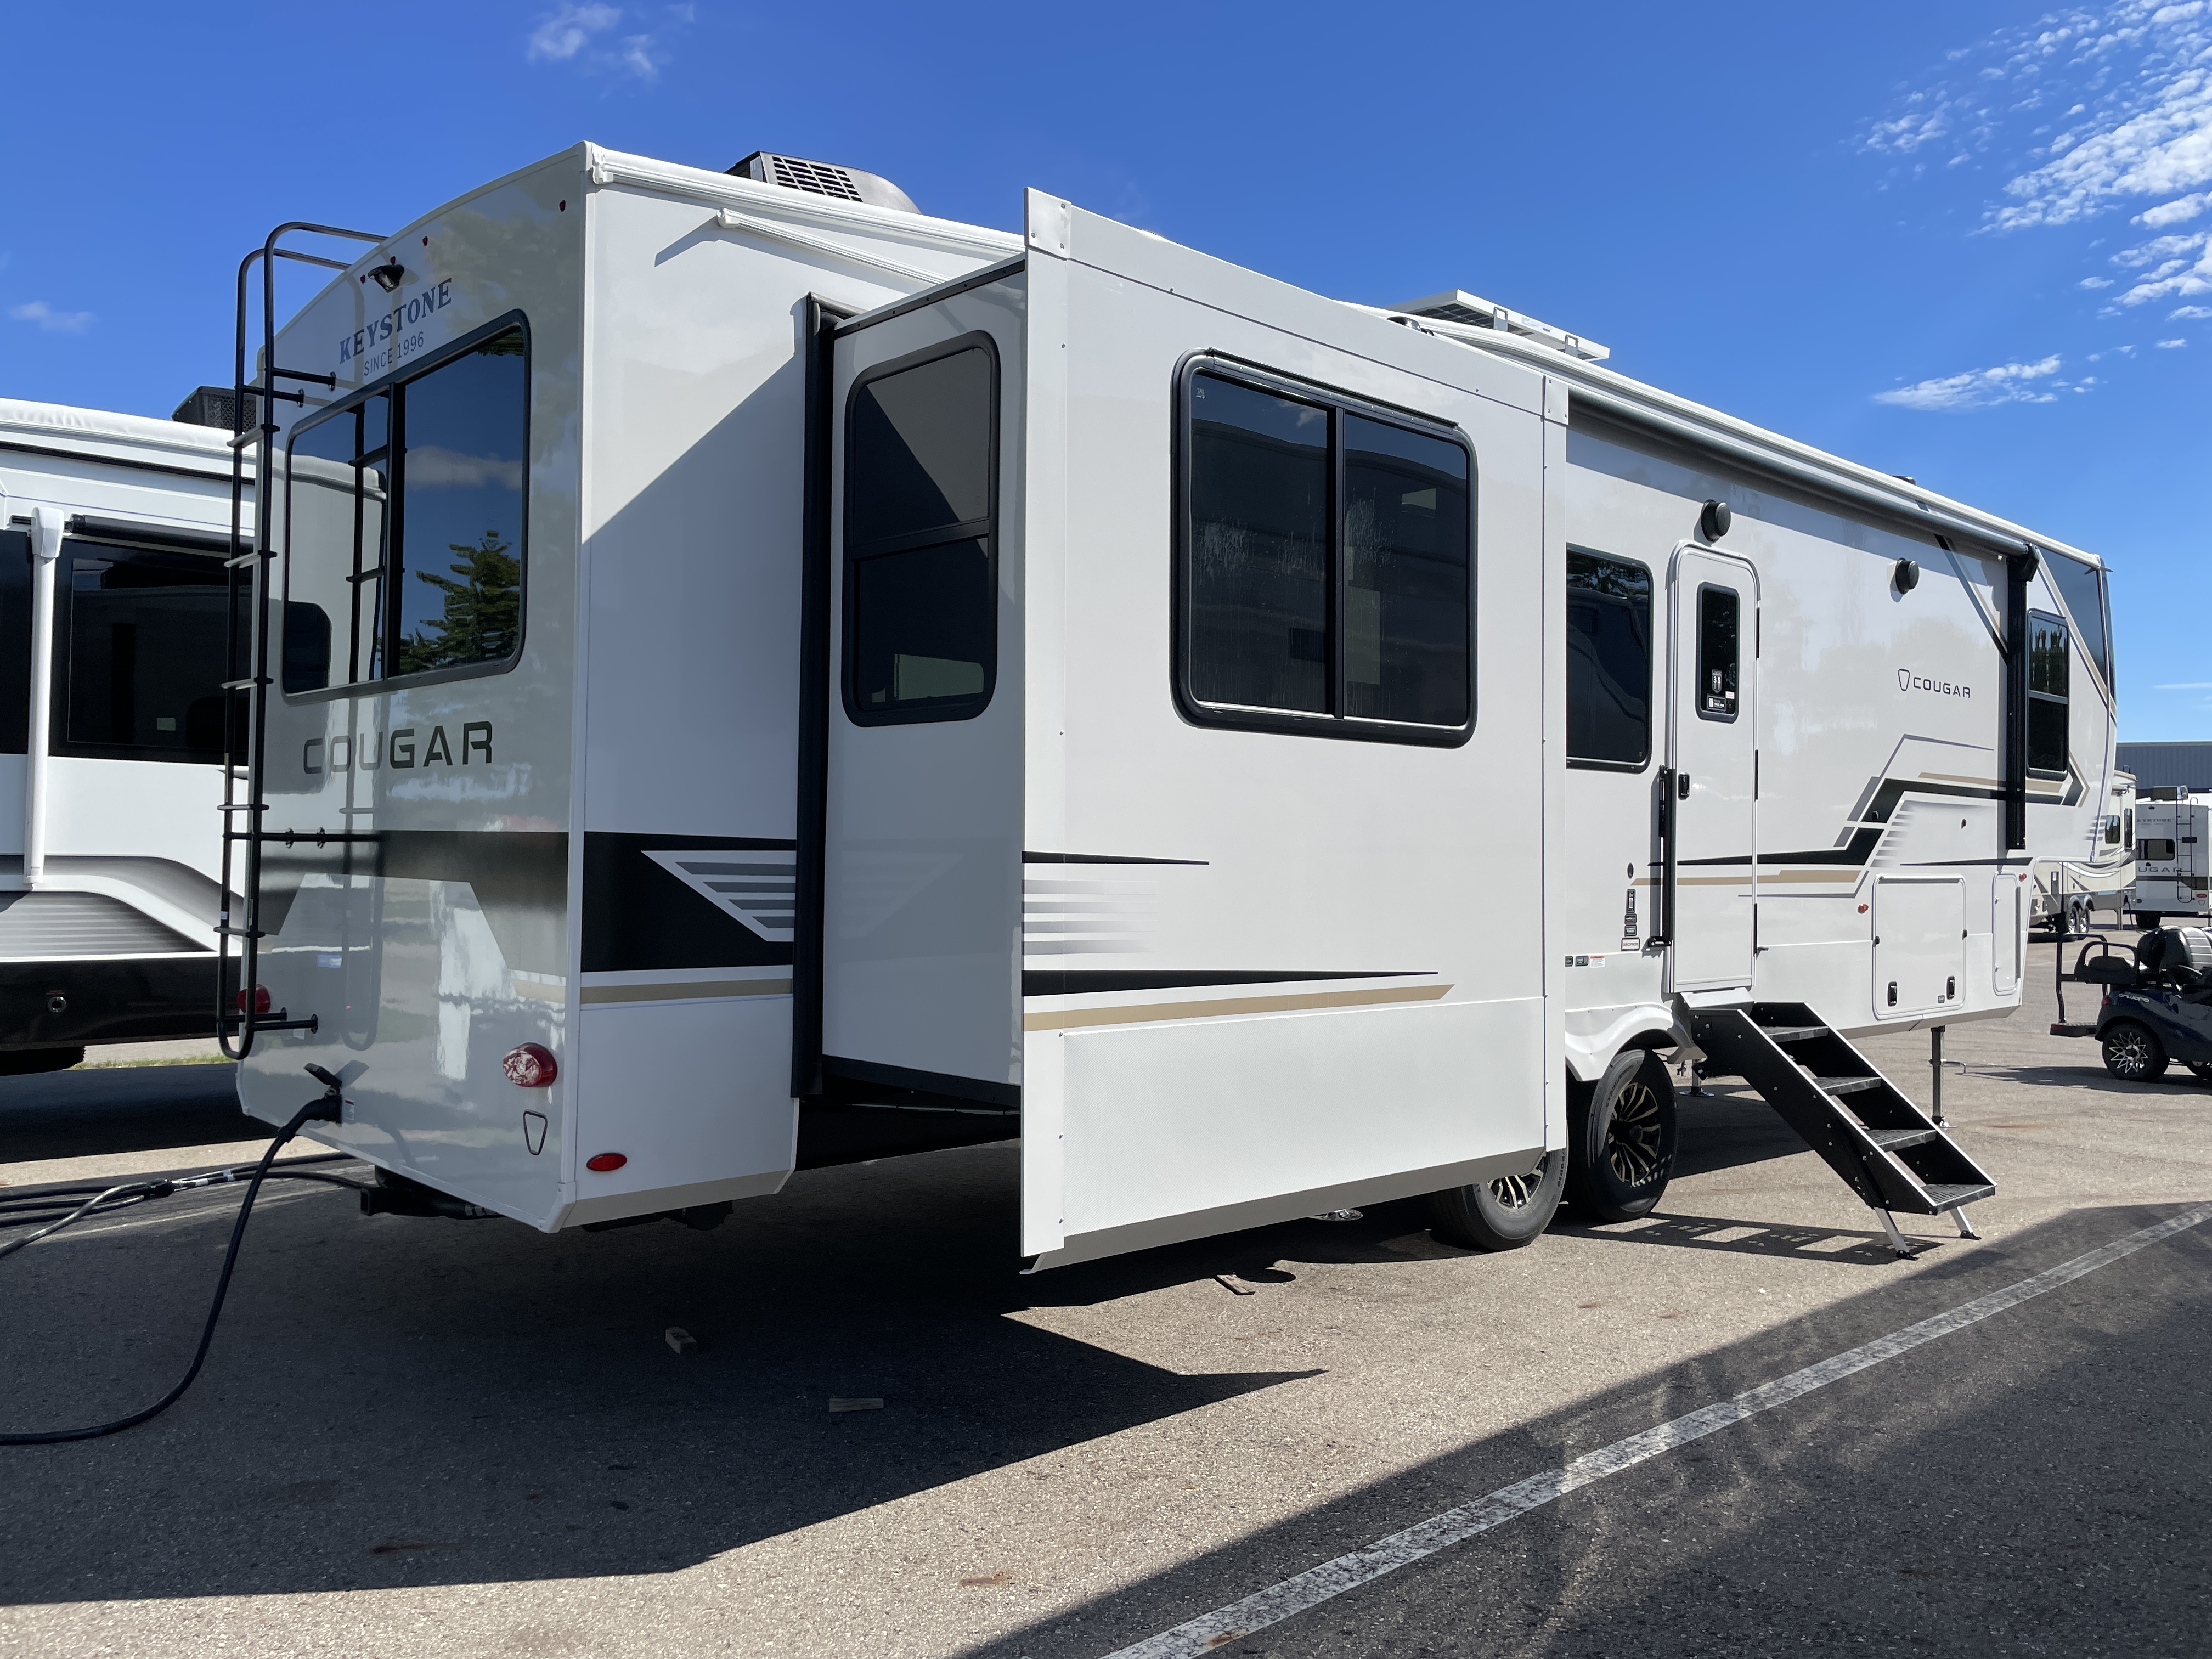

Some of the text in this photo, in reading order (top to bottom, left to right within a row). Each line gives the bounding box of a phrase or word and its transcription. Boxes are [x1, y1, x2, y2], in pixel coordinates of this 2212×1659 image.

[339, 277, 452, 364] KEYSTONE
[364, 331, 424, 376] SINCE 1996
[1913, 676, 1971, 699] COUGAR
[303, 720, 493, 775] COUGAR
